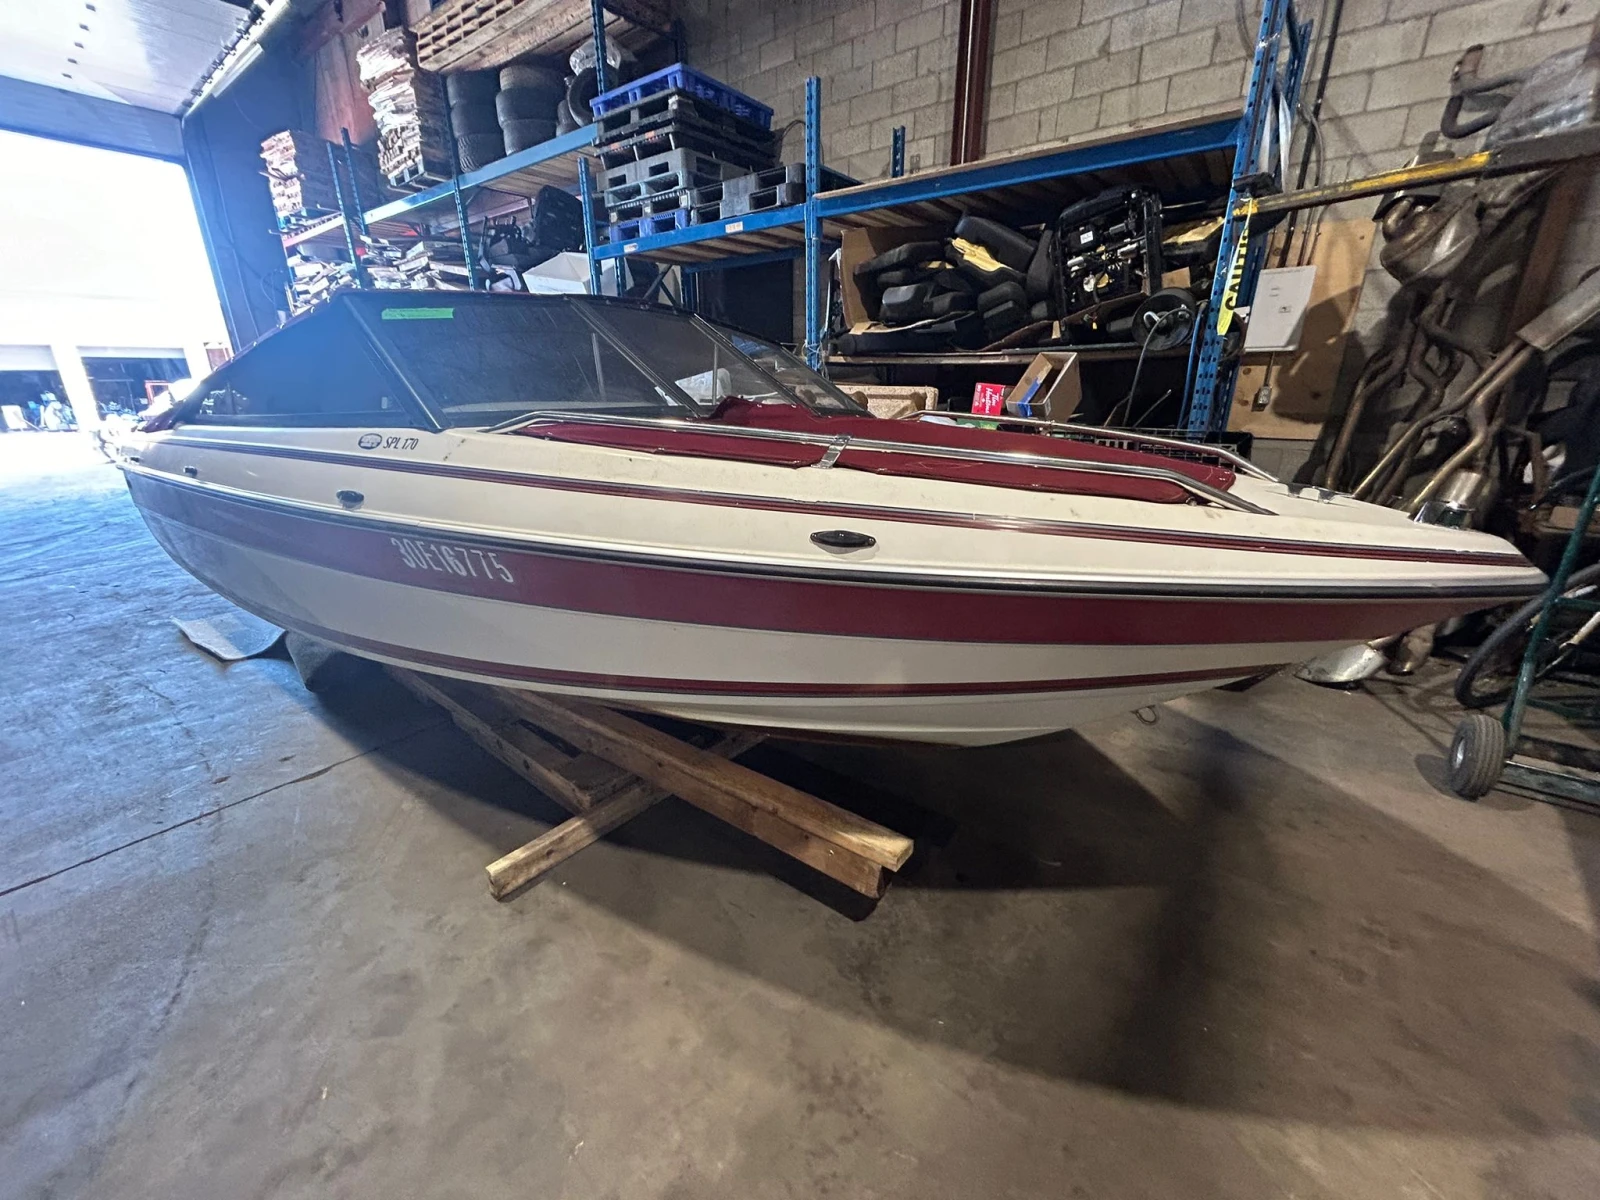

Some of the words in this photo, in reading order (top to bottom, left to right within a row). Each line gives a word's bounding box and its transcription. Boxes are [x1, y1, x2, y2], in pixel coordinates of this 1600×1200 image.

[991, 392, 1000, 406] Tim
[383, 436, 401, 449] SPL
[402, 437, 419, 450] 170
[391, 537, 514, 583] 30E16775
